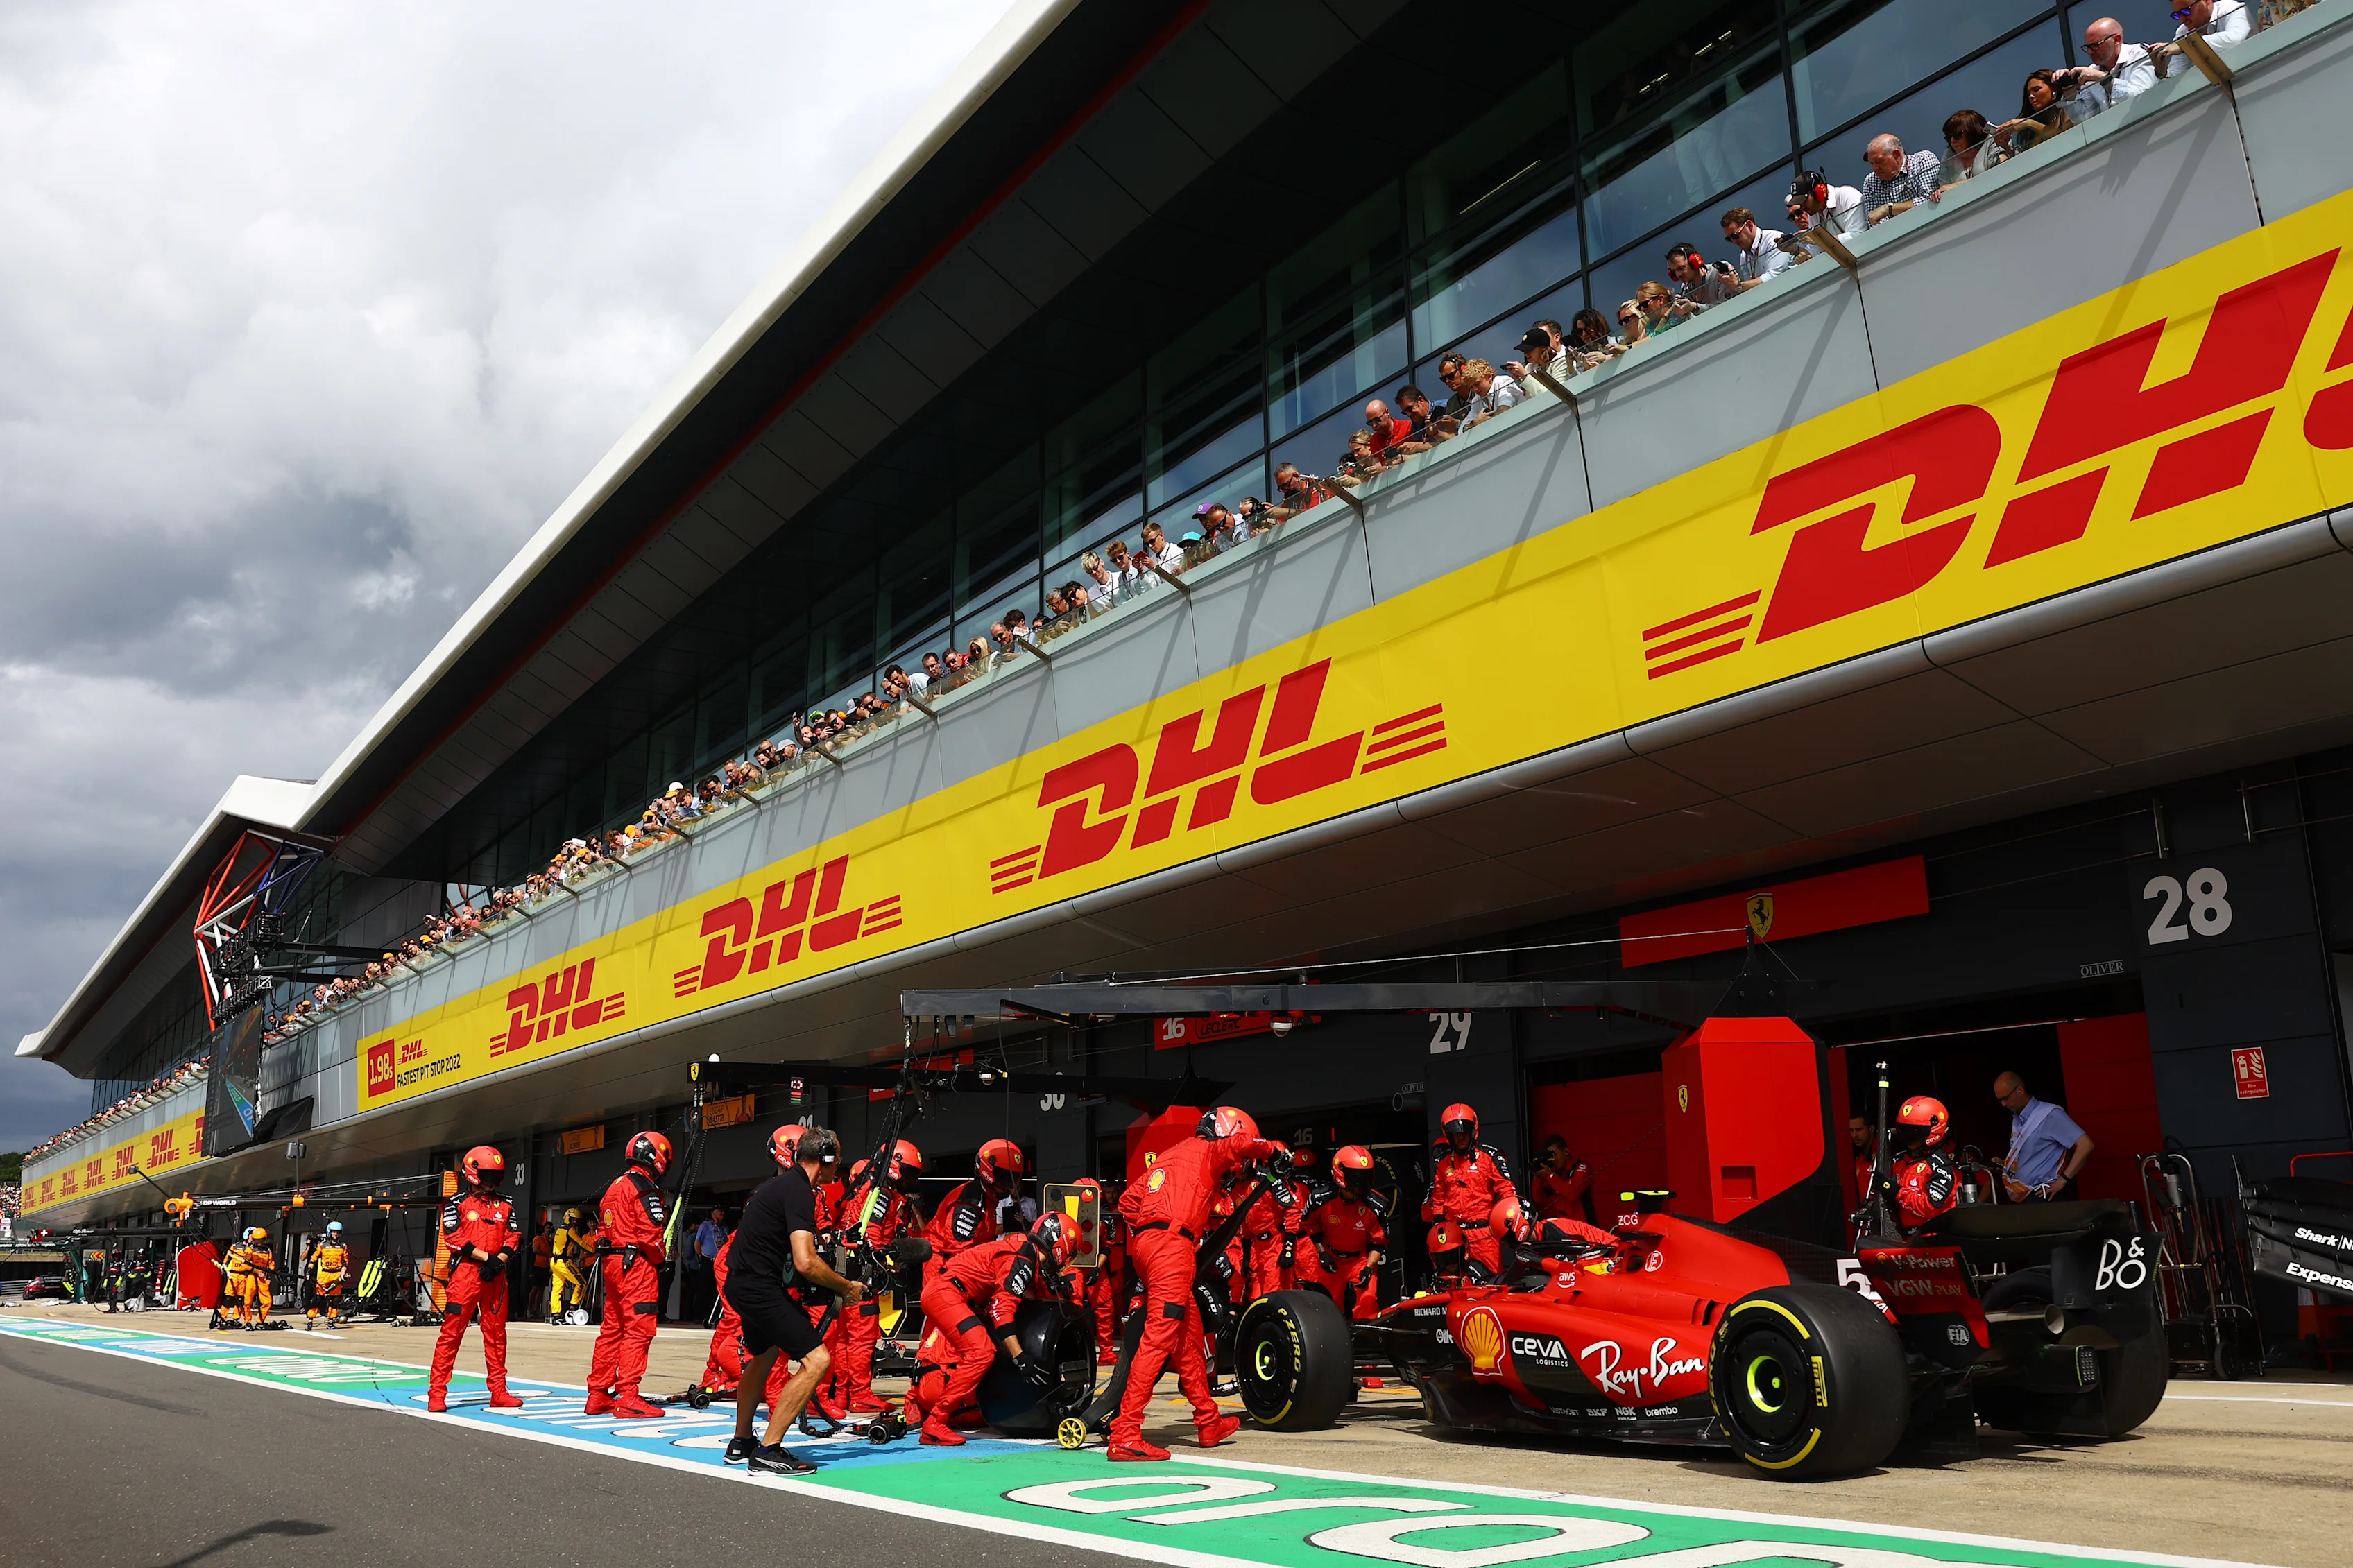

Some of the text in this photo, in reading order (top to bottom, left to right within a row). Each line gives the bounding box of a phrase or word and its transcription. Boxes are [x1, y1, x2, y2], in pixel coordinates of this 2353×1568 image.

[1751, 247, 2353, 644] DH
[1038, 657, 1364, 879] DHL
[2143, 868, 2232, 945] 28
[700, 854, 863, 990] DHL
[2080, 962, 2124, 976] OLIVER
[506, 958, 603, 1052] DHL
[1163, 1017, 1186, 1041] 16
[1429, 1013, 1472, 1054] 29
[401, 1039, 424, 1064] DHL
[397, 1053, 461, 1088] FASTEST PIT STOP 2022
[1401, 1083, 1424, 1094] OLIVER
[151, 1129, 176, 1168] DHL
[1293, 1128, 1313, 1146] 16
[515, 1163, 525, 1187] 33
[1375, 1155, 1396, 1180] ZERO
[1929, 1189, 1944, 1200] VGW
[957, 1225, 970, 1237] VGW
[1891, 1254, 1956, 1270] V-Power
[1559, 1272, 1576, 1282] aws
[1884, 1280, 1934, 1296] VGW
[2286, 1261, 2353, 1292] Expens
[1198, 1284, 1217, 1313] ZERO
[1414, 1307, 1441, 1317] RICHARD
[1277, 1307, 1289, 1316] P
[1285, 1319, 1302, 1373] ZERO
[1535, 1358, 1569, 1368] LOGISTICS
[1811, 1356, 1829, 1408] PIRELLI
[1586, 1408, 1608, 1417] SKF
[1614, 1406, 1636, 1416] NGK
[1644, 1406, 1679, 1418] brembo
